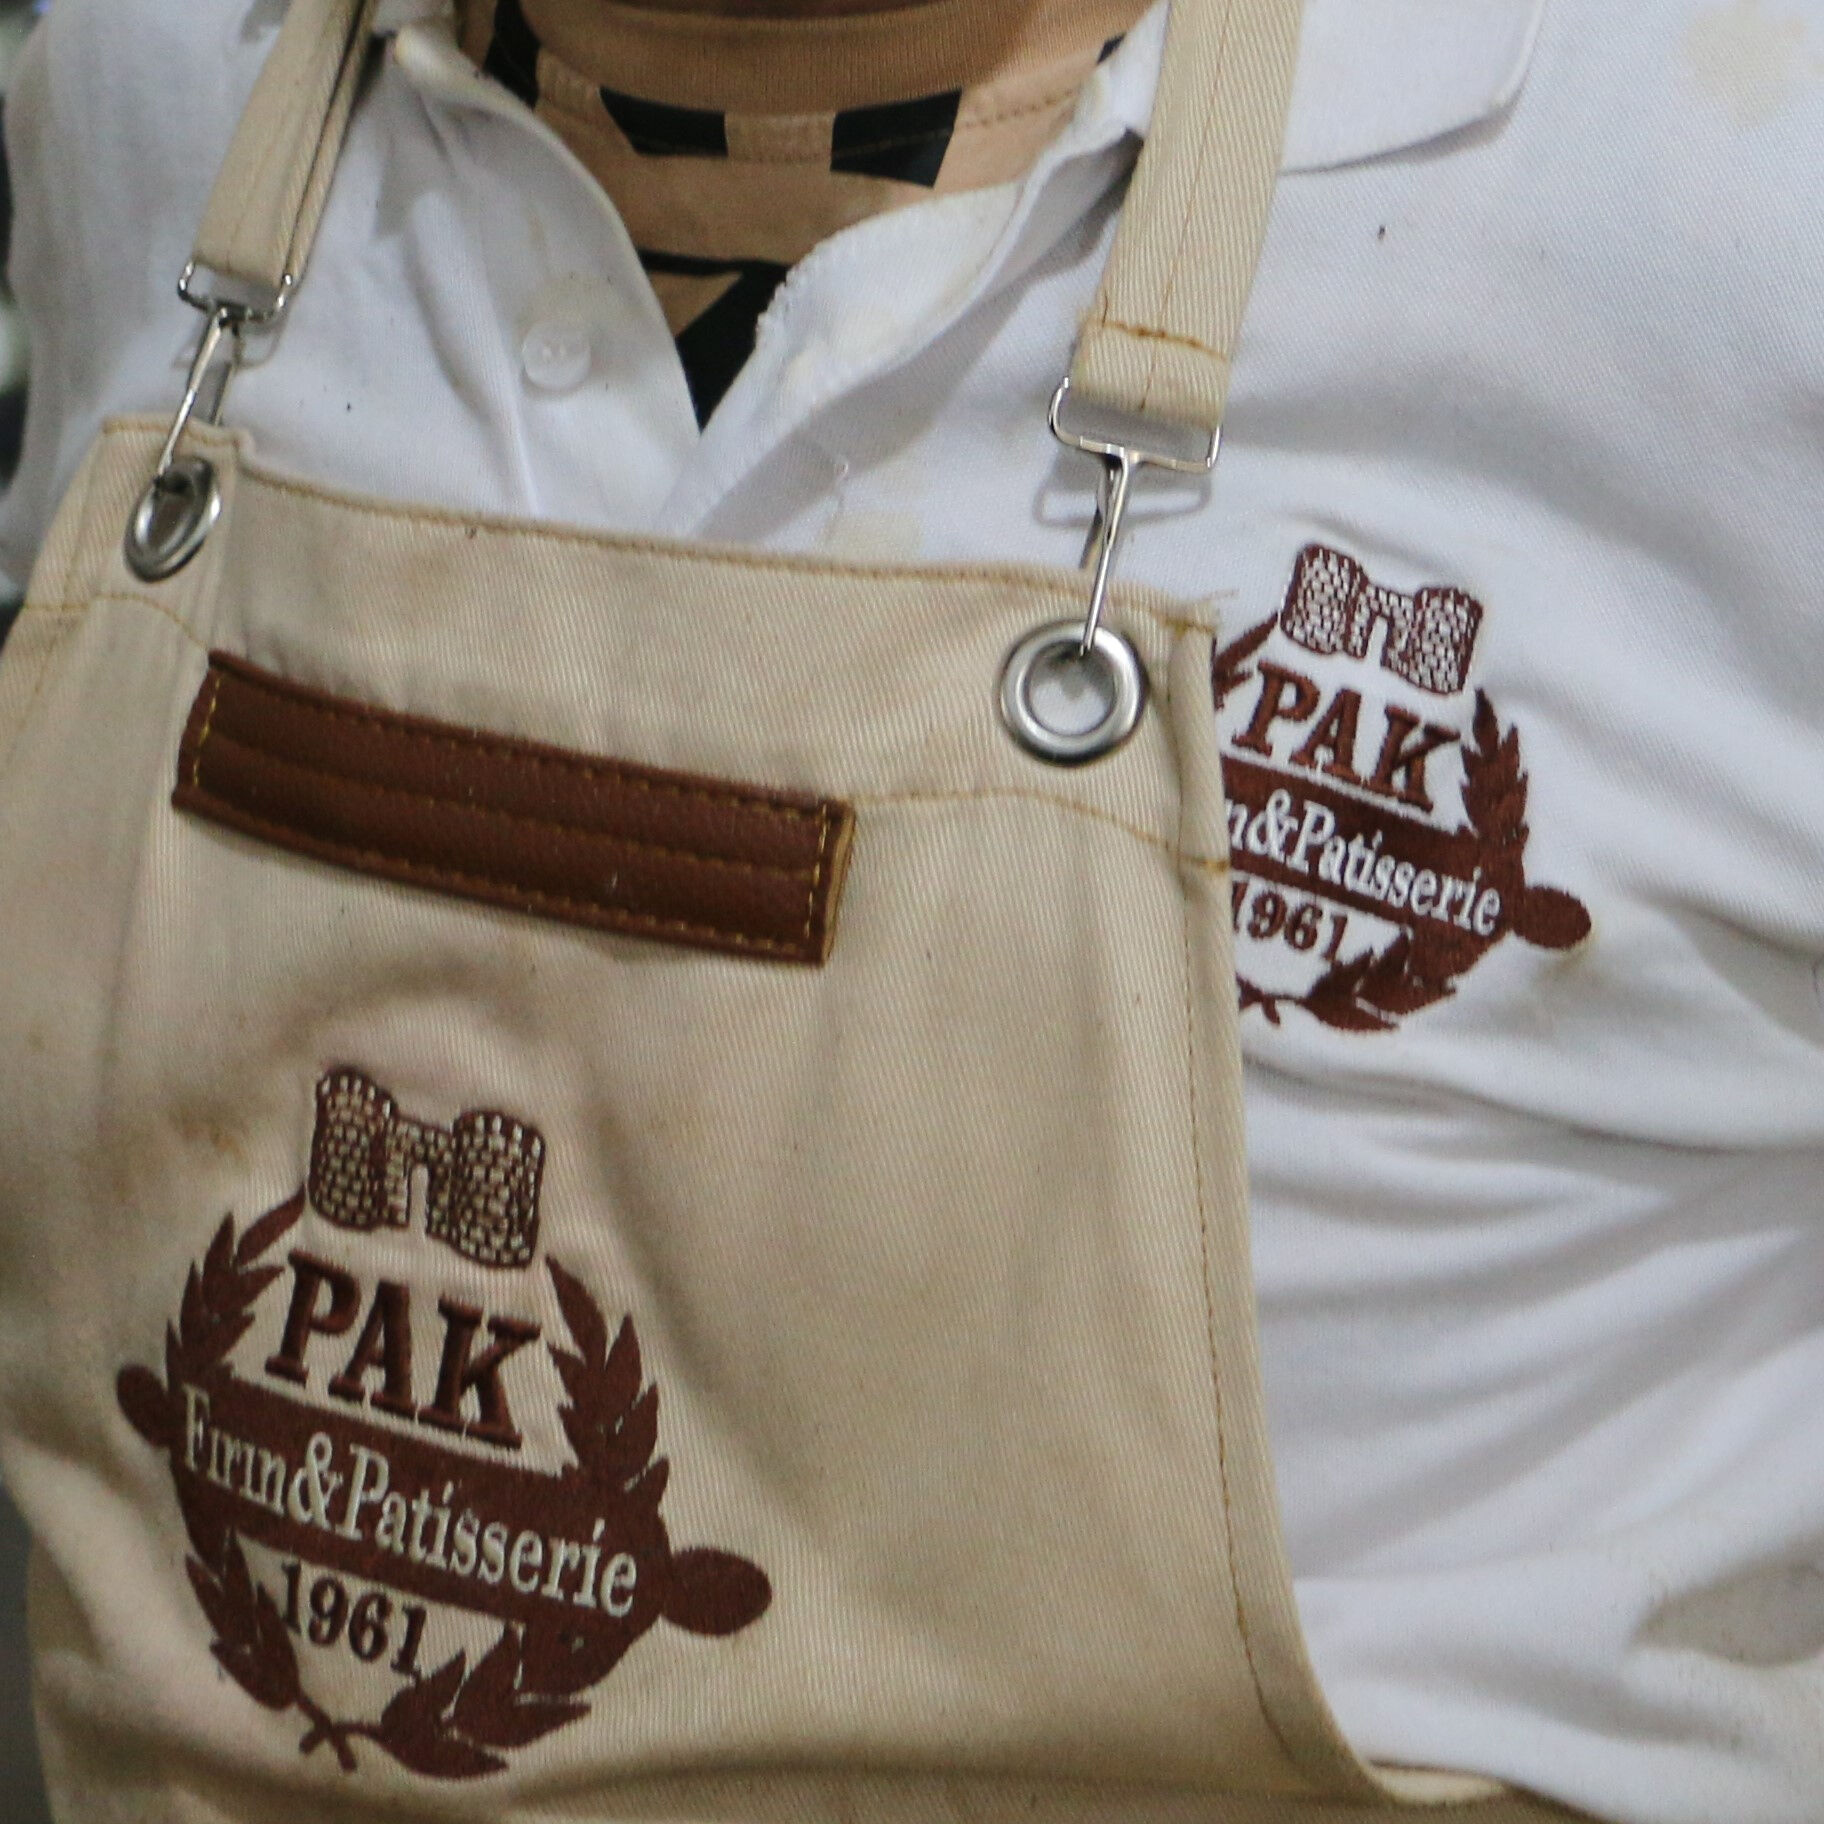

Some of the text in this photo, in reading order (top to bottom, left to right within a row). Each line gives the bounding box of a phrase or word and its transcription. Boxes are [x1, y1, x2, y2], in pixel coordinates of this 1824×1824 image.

[1231, 659, 1461, 813] PAK
[1232, 880, 1349, 963] 1961
[264, 1250, 542, 1449] PAK
[280, 1559, 428, 1678] 1961
